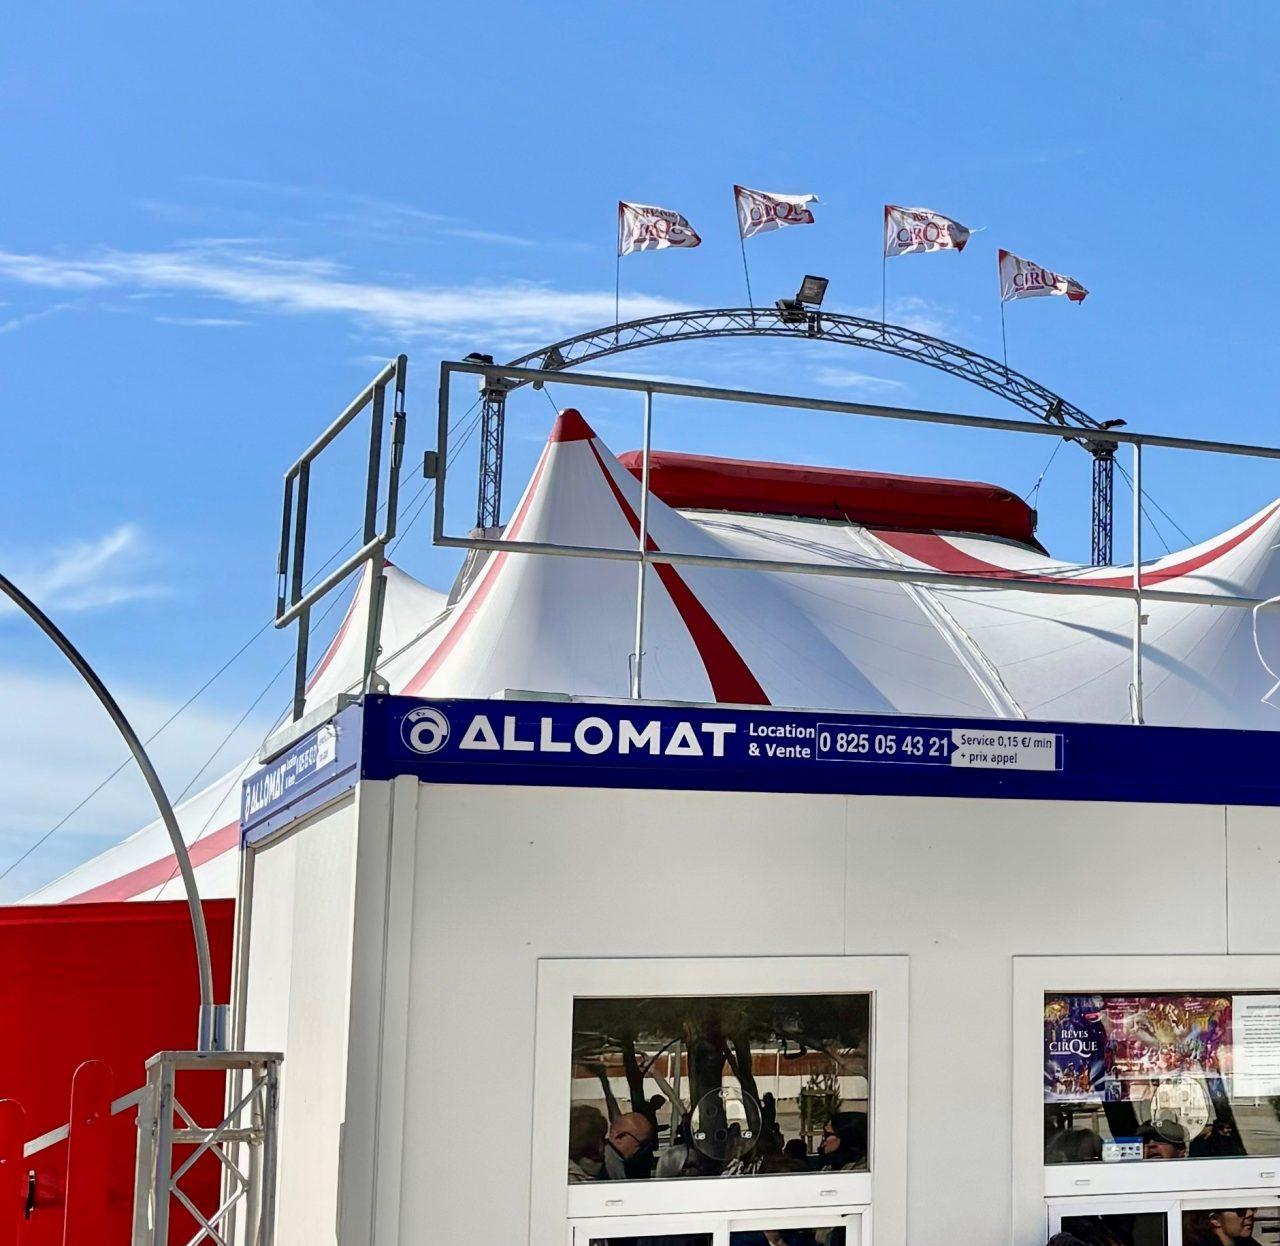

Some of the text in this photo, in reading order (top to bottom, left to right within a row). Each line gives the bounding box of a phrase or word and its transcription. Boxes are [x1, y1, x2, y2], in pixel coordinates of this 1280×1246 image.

[459, 714, 737, 757] ALLOMAT
[749, 722, 815, 739] Location
[748, 742, 811, 759] & Vente
[819, 732, 949, 757] 0 825 05 43 21
[961, 734, 995, 747] Service
[998, 735, 1019, 749] 0,15
[1033, 737, 1052, 749] min
[969, 751, 988, 764] prix
[990, 753, 1018, 766] appel
[249, 764, 287, 815] ALLOMAT
[1049, 1039, 1098, 1058] CIRQUE
